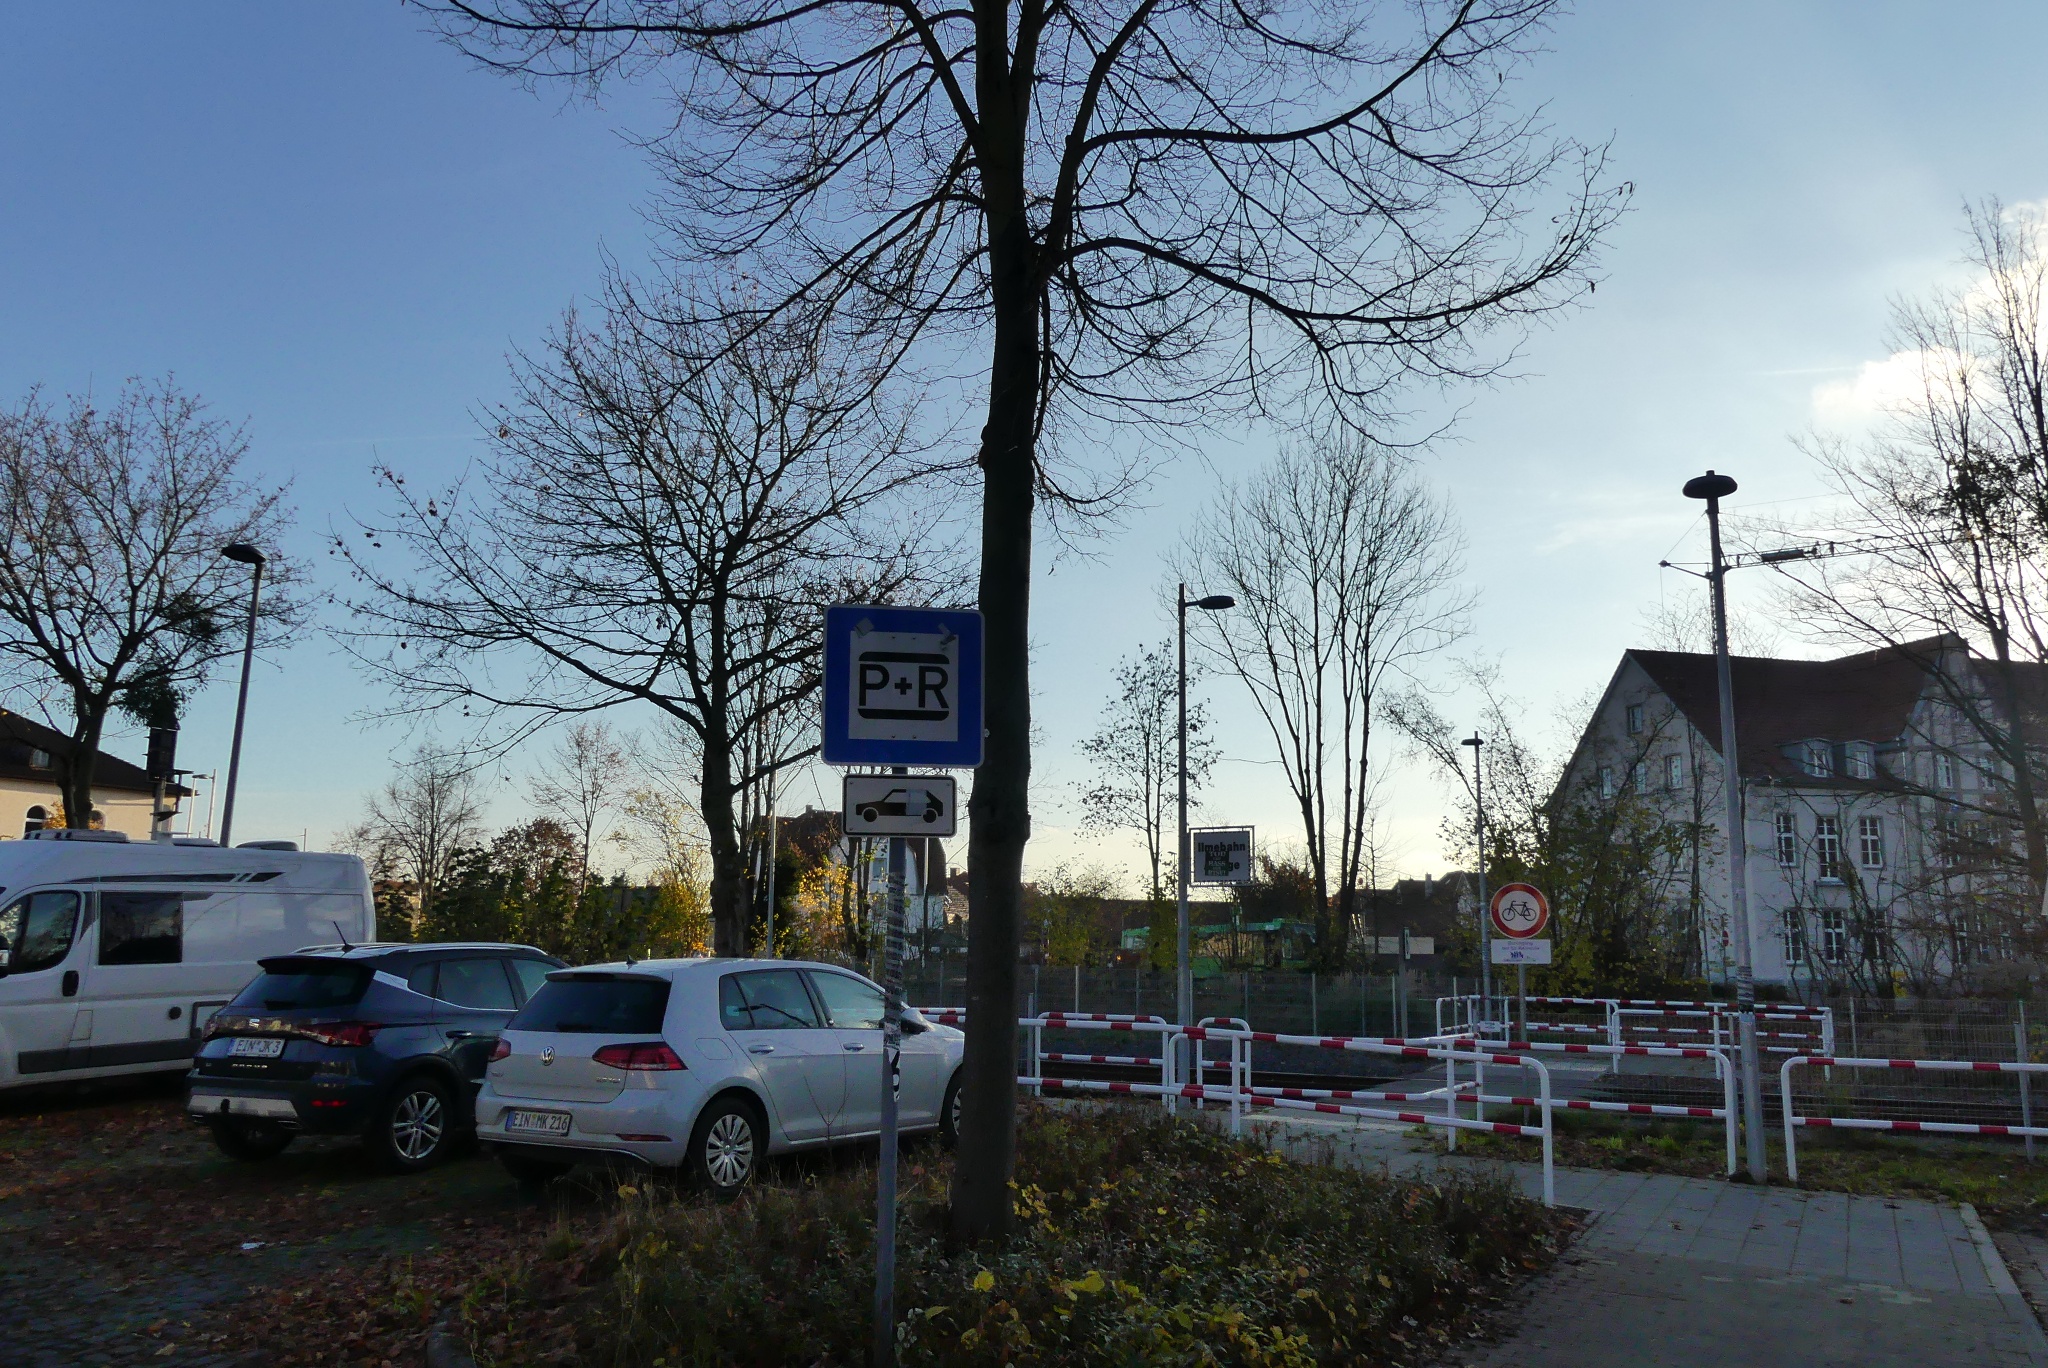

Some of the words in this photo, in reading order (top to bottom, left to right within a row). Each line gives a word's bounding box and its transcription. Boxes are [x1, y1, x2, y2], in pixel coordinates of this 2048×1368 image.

[859, 664, 950, 709] P+R
[1198, 842, 1245, 852] Ilmebahn
[236, 1039, 256, 1052] EIN
[513, 1112, 532, 1128] EIN
[536, 1114, 549, 1129] MK
[549, 1115, 568, 1131] 216
